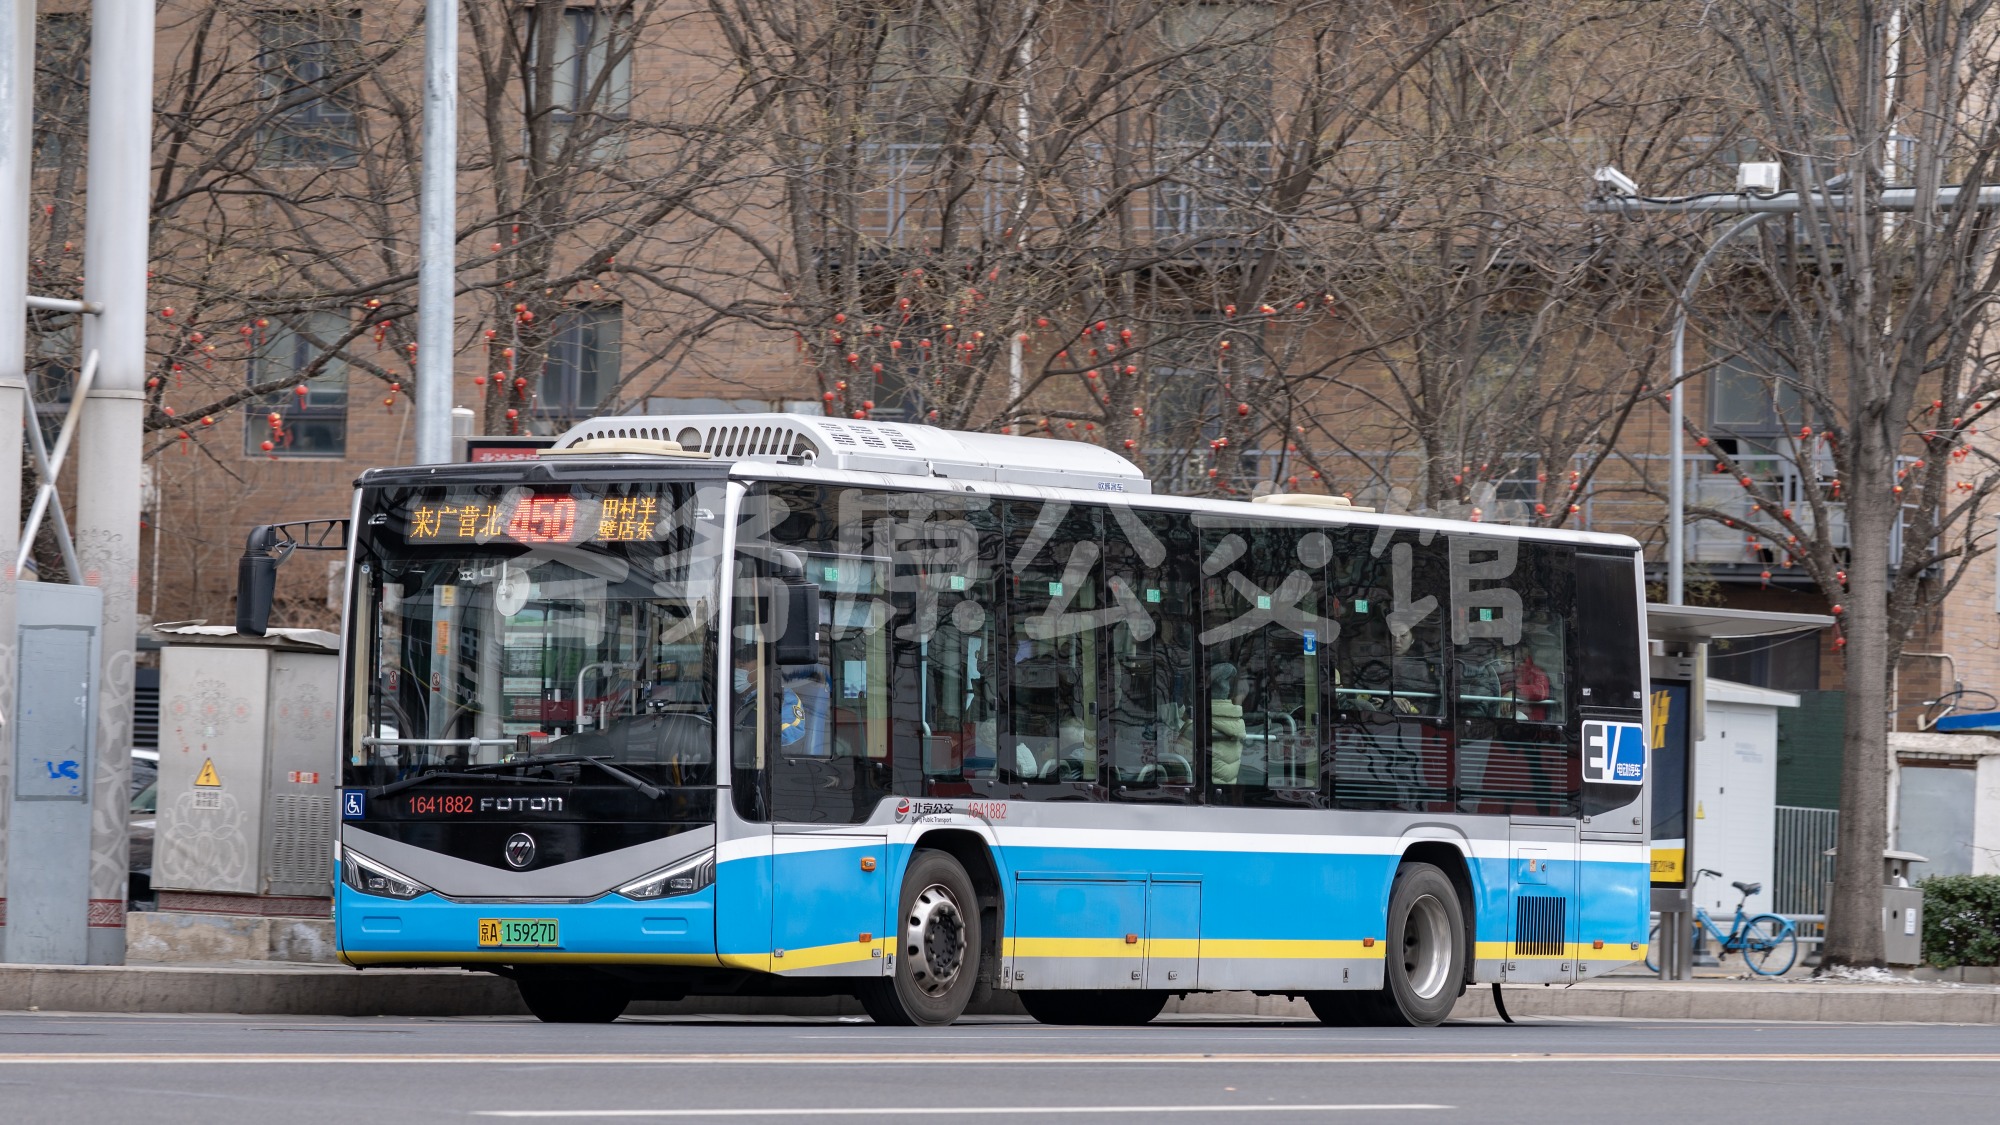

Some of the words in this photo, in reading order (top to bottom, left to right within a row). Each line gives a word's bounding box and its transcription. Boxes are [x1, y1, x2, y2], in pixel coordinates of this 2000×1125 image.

[602, 497, 657, 520] 田村半
[410, 505, 503, 538] 来广营北
[508, 497, 576, 543] 450
[597, 520, 656, 542] 壁店东
[1584, 724, 1622, 780] EV
[1616, 763, 1641, 777] 电动汽车
[409, 796, 473, 814] 1641882
[480, 797, 563, 811] FOTON
[912, 803, 953, 815] 北京公交
[968, 802, 1006, 819] 1641882
